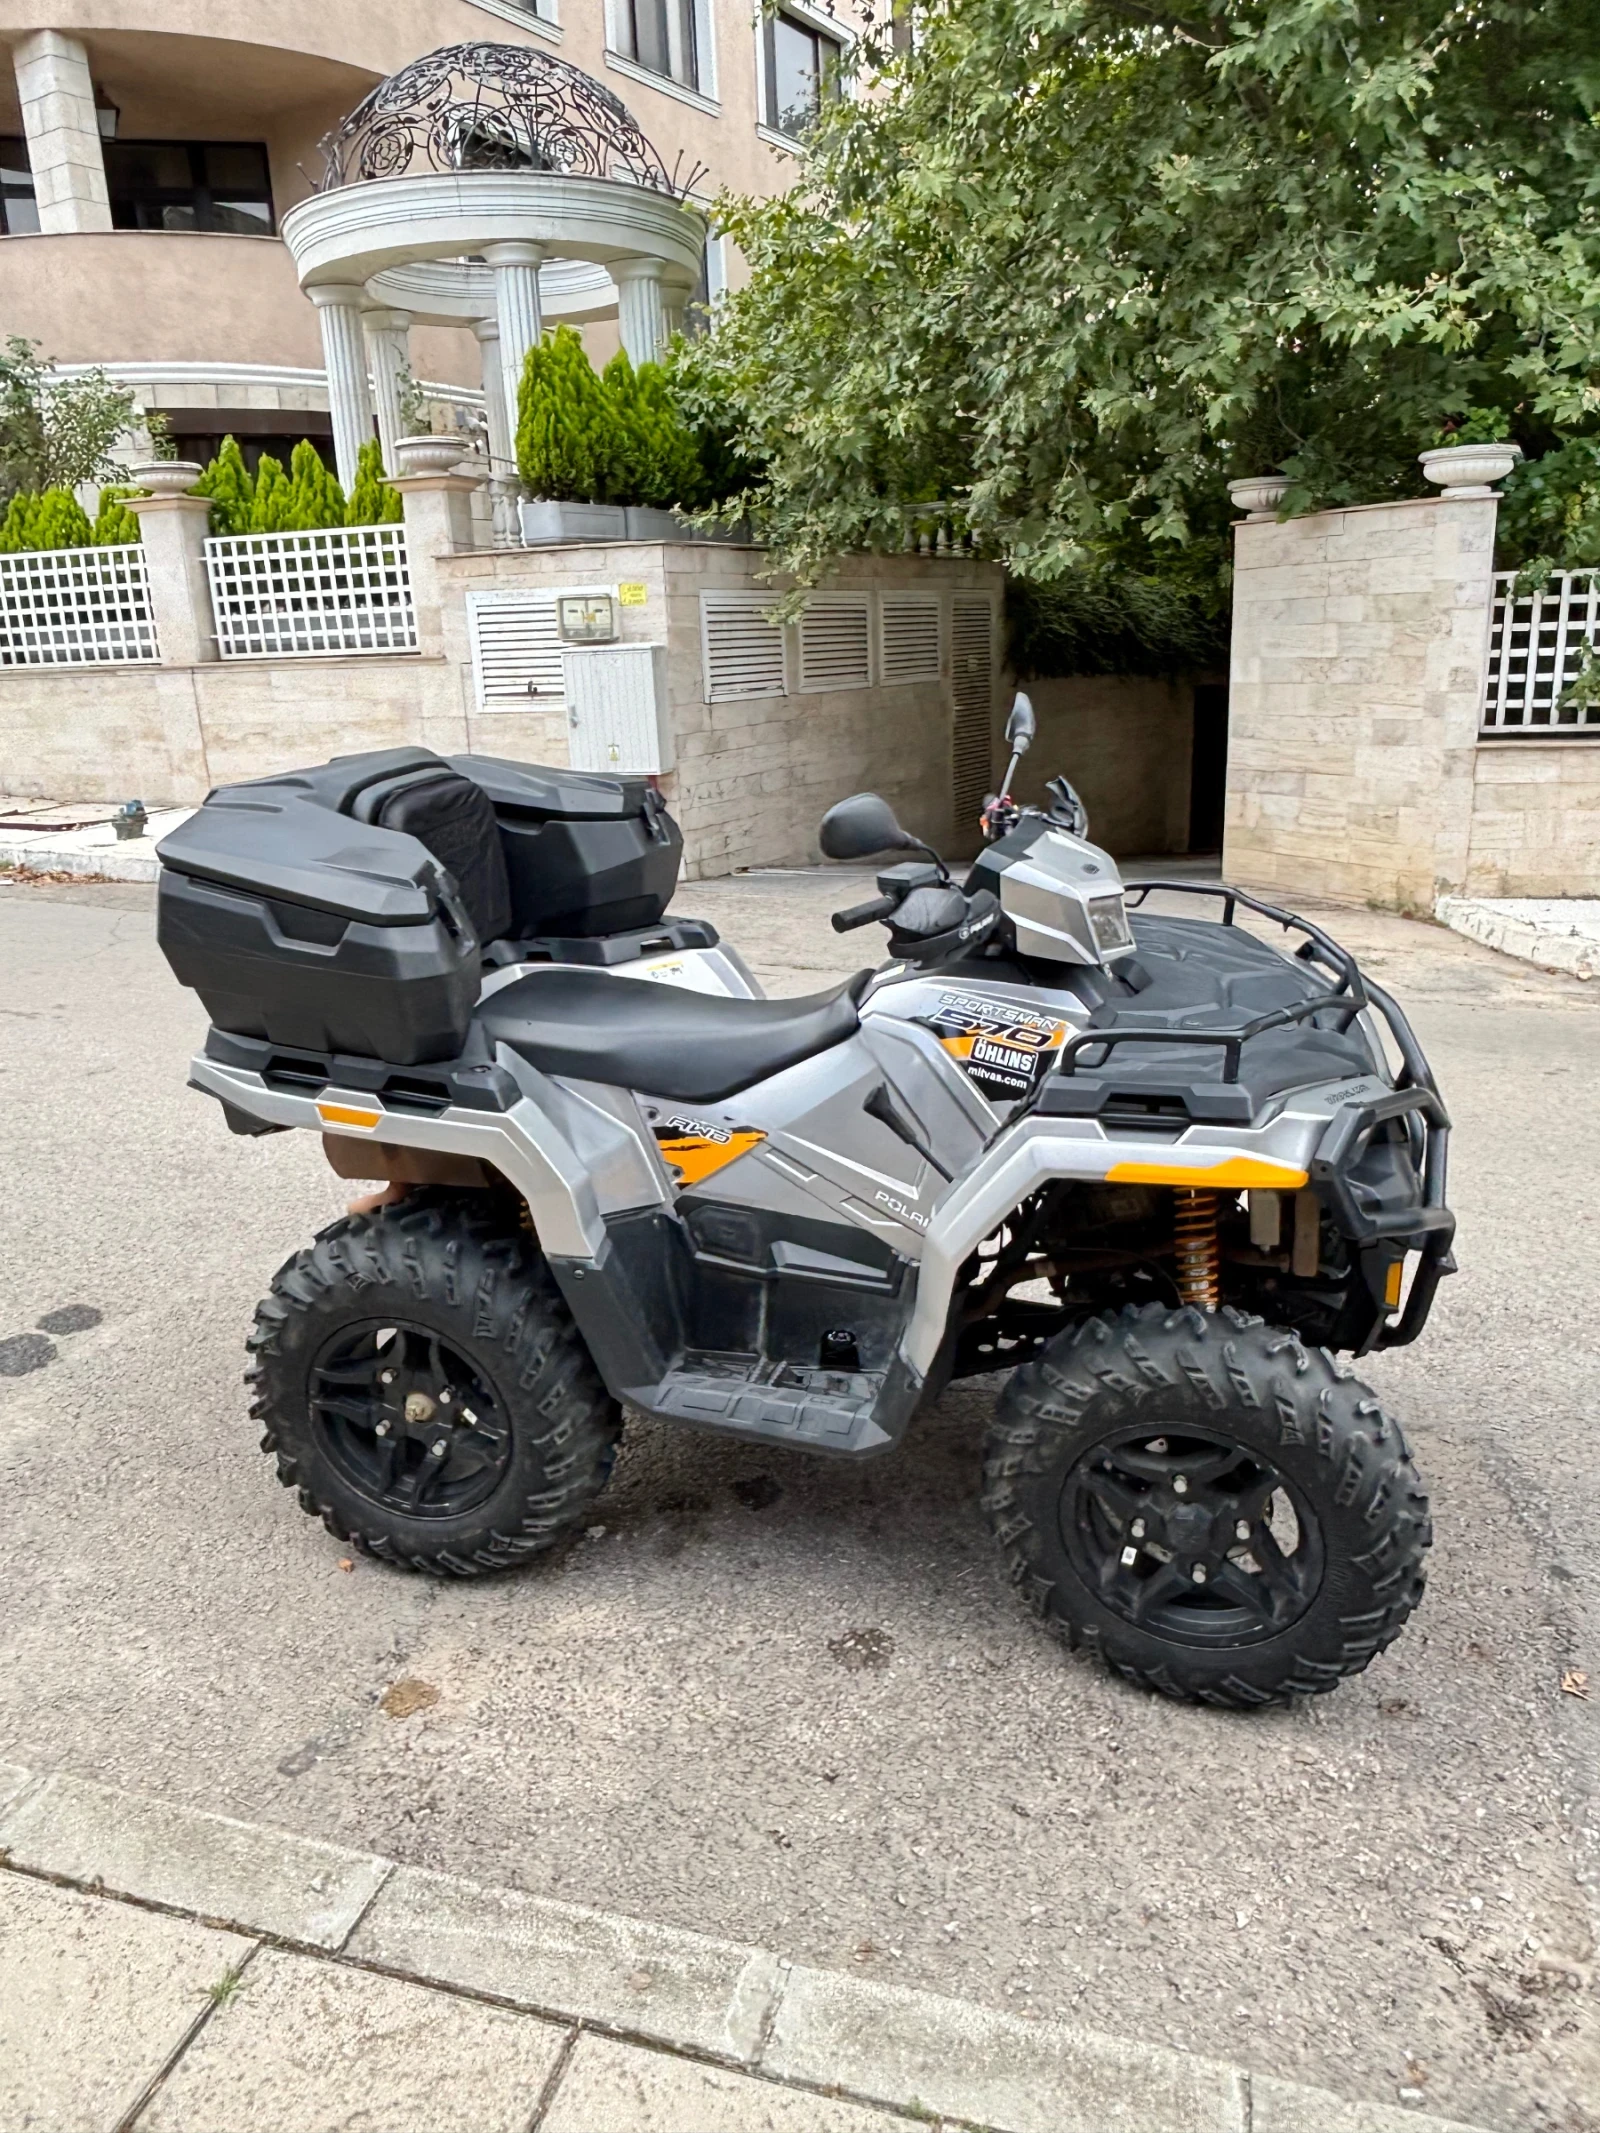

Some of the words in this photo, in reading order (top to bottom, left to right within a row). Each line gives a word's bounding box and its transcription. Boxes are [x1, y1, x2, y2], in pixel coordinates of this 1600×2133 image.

[933, 1006, 1054, 1049] 570
[940, 994, 1059, 1030] SPORTSMAN
[973, 1038, 1033, 1072] ÖHLINS
[967, 1065, 1028, 1090] mitvas.com
[666, 1115, 731, 1145] AWD
